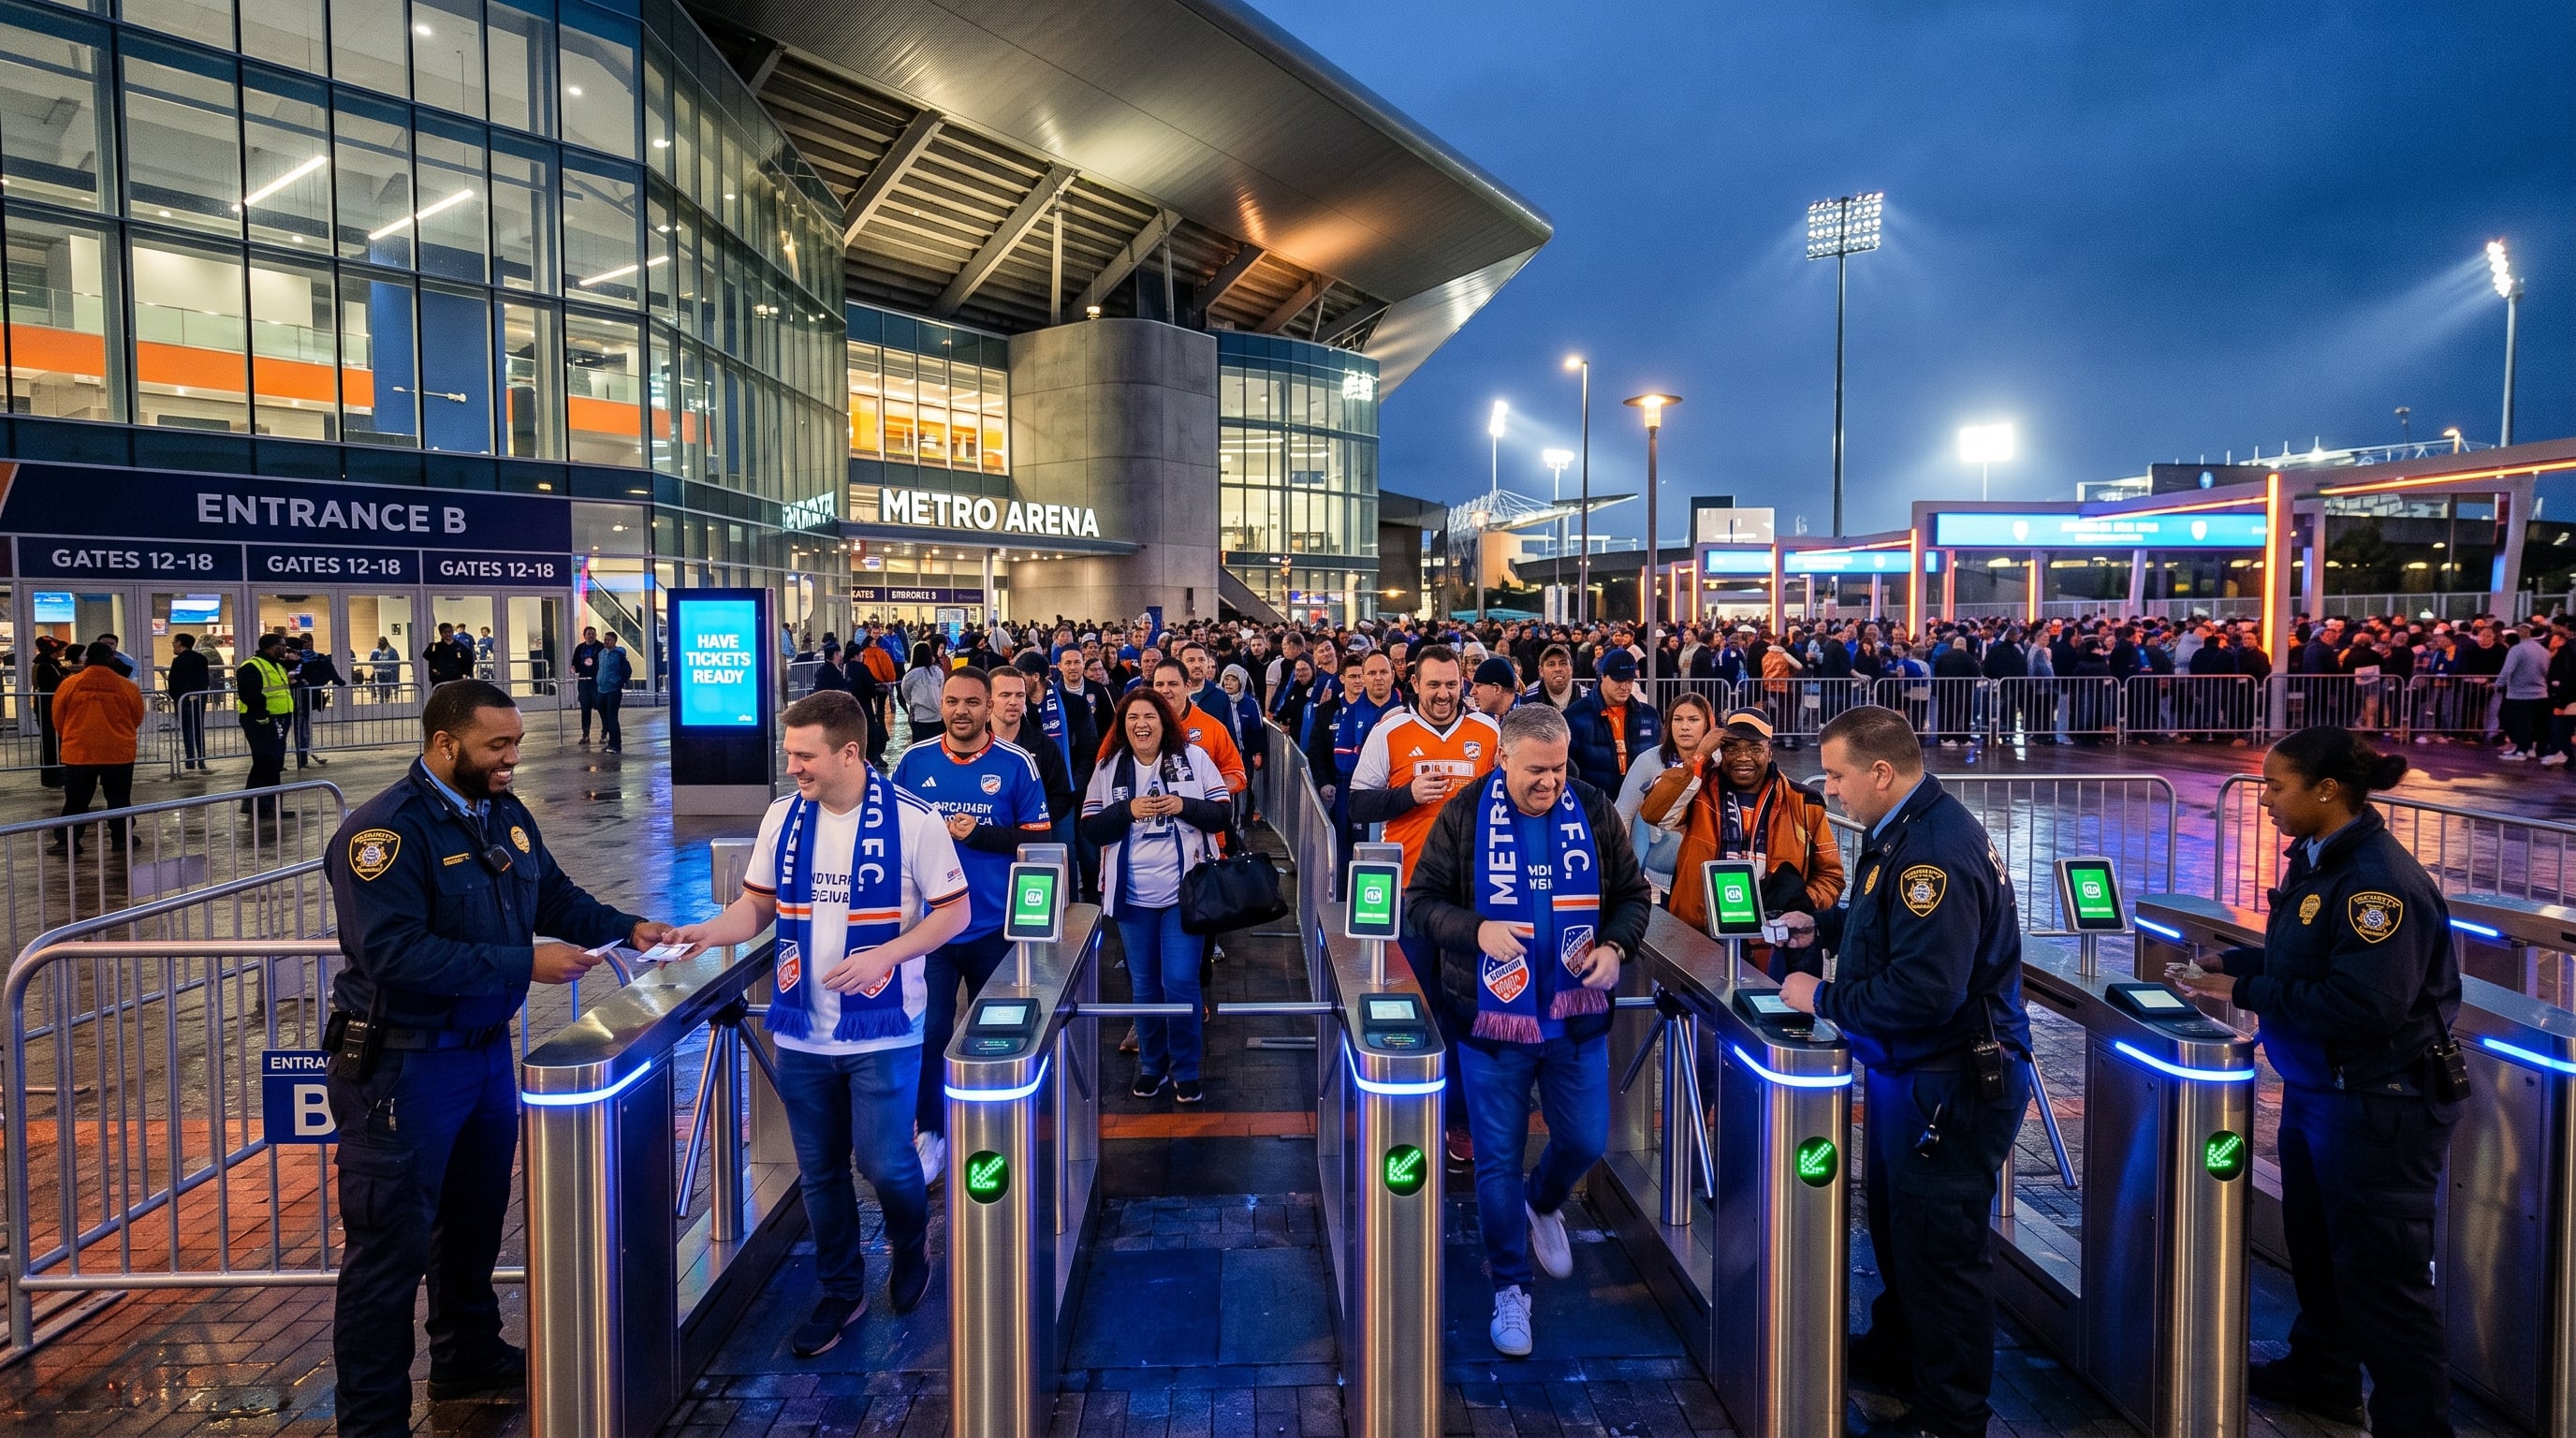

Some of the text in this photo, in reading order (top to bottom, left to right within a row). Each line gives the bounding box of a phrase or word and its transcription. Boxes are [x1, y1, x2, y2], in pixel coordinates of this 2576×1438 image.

[197, 492, 467, 534] ENTRANCE B
[881, 488, 998, 531] METRO
[1004, 501, 1101, 538] ARENA
[51, 549, 213, 570] GATES 12-18
[267, 556, 402, 575] GATES 12-18
[440, 560, 555, 579] GATES 12-18
[696, 634, 739, 649] HAVE
[685, 652, 752, 667] TICKETS
[693, 669, 745, 684] READY
[294, 1084, 336, 1136] B
